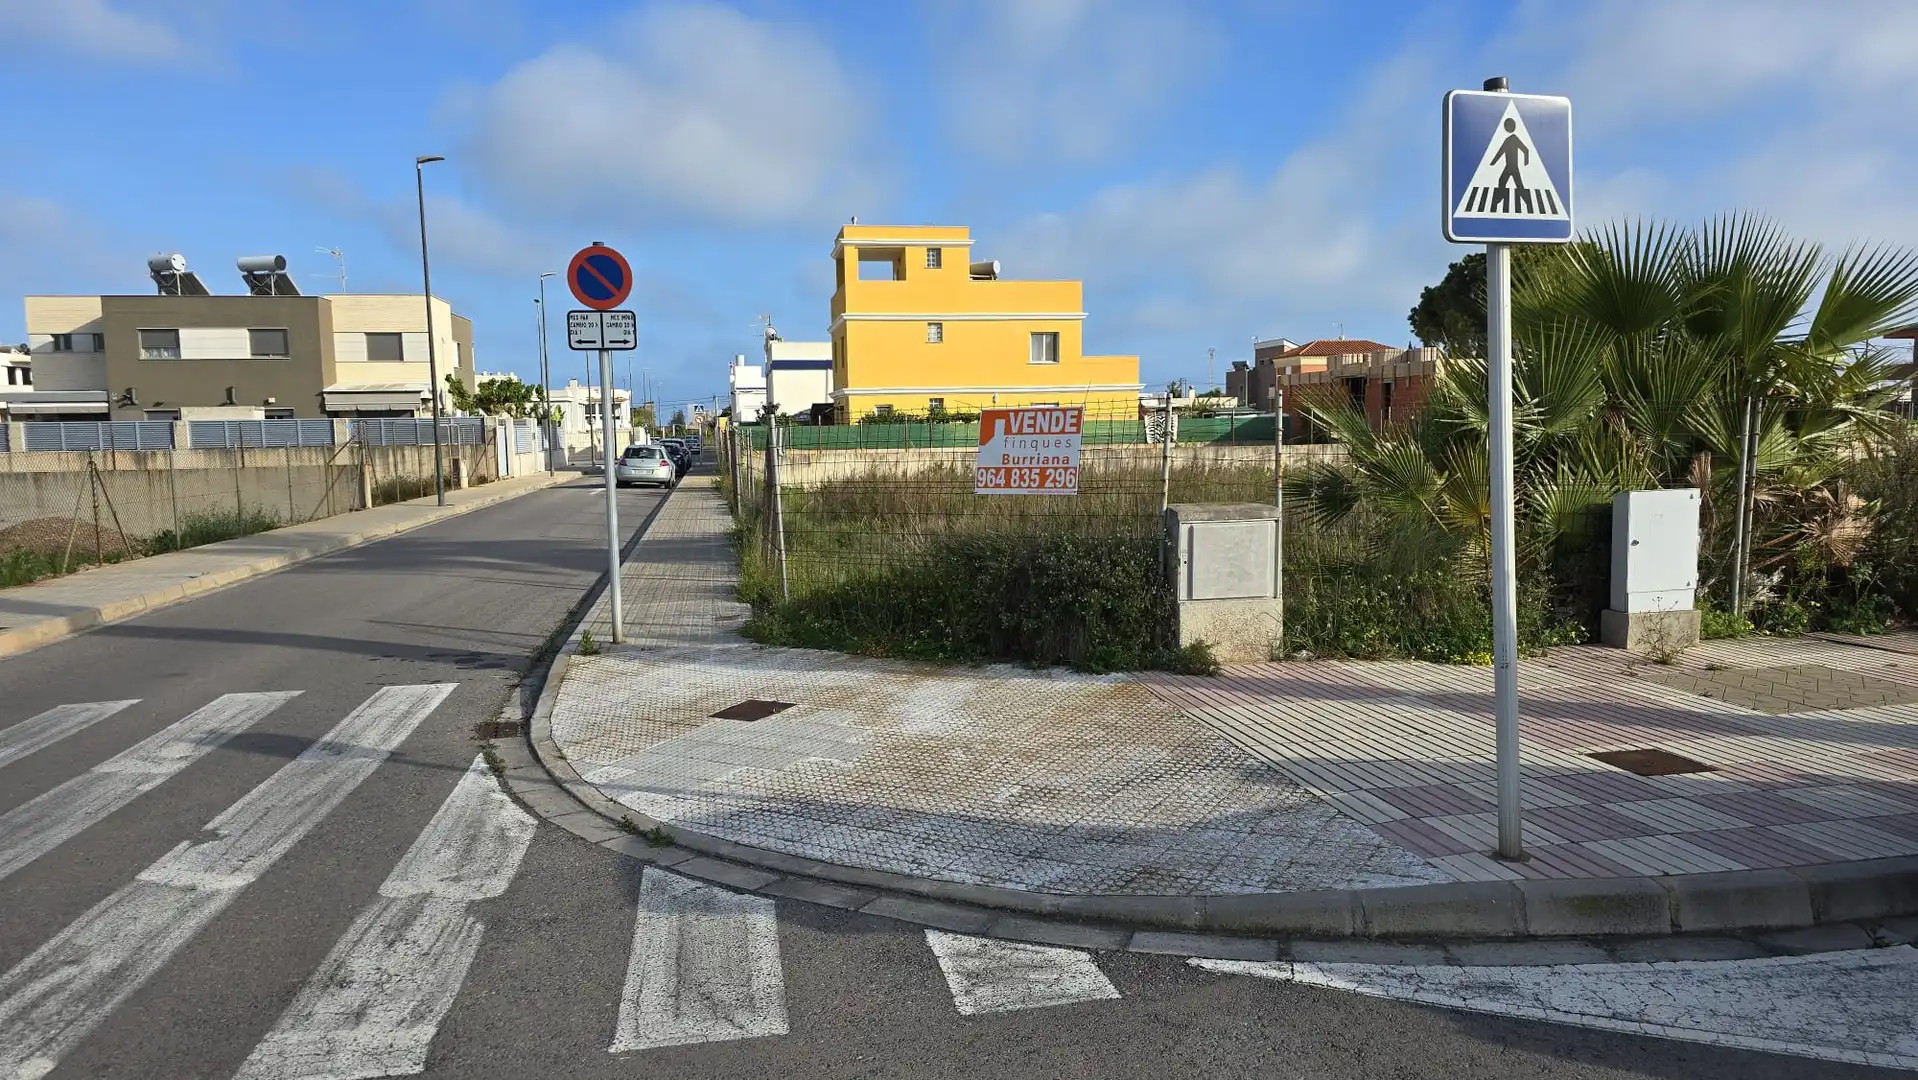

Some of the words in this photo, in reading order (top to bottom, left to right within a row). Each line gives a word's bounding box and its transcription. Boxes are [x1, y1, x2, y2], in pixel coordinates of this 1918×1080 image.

[1009, 410, 1079, 433] VENDE
[1004, 437, 1072, 451] finques
[1002, 453, 1070, 465] Burriana
[977, 469, 1005, 488] 964
[1011, 469, 1040, 488] 835
[1045, 468, 1076, 488] 296
